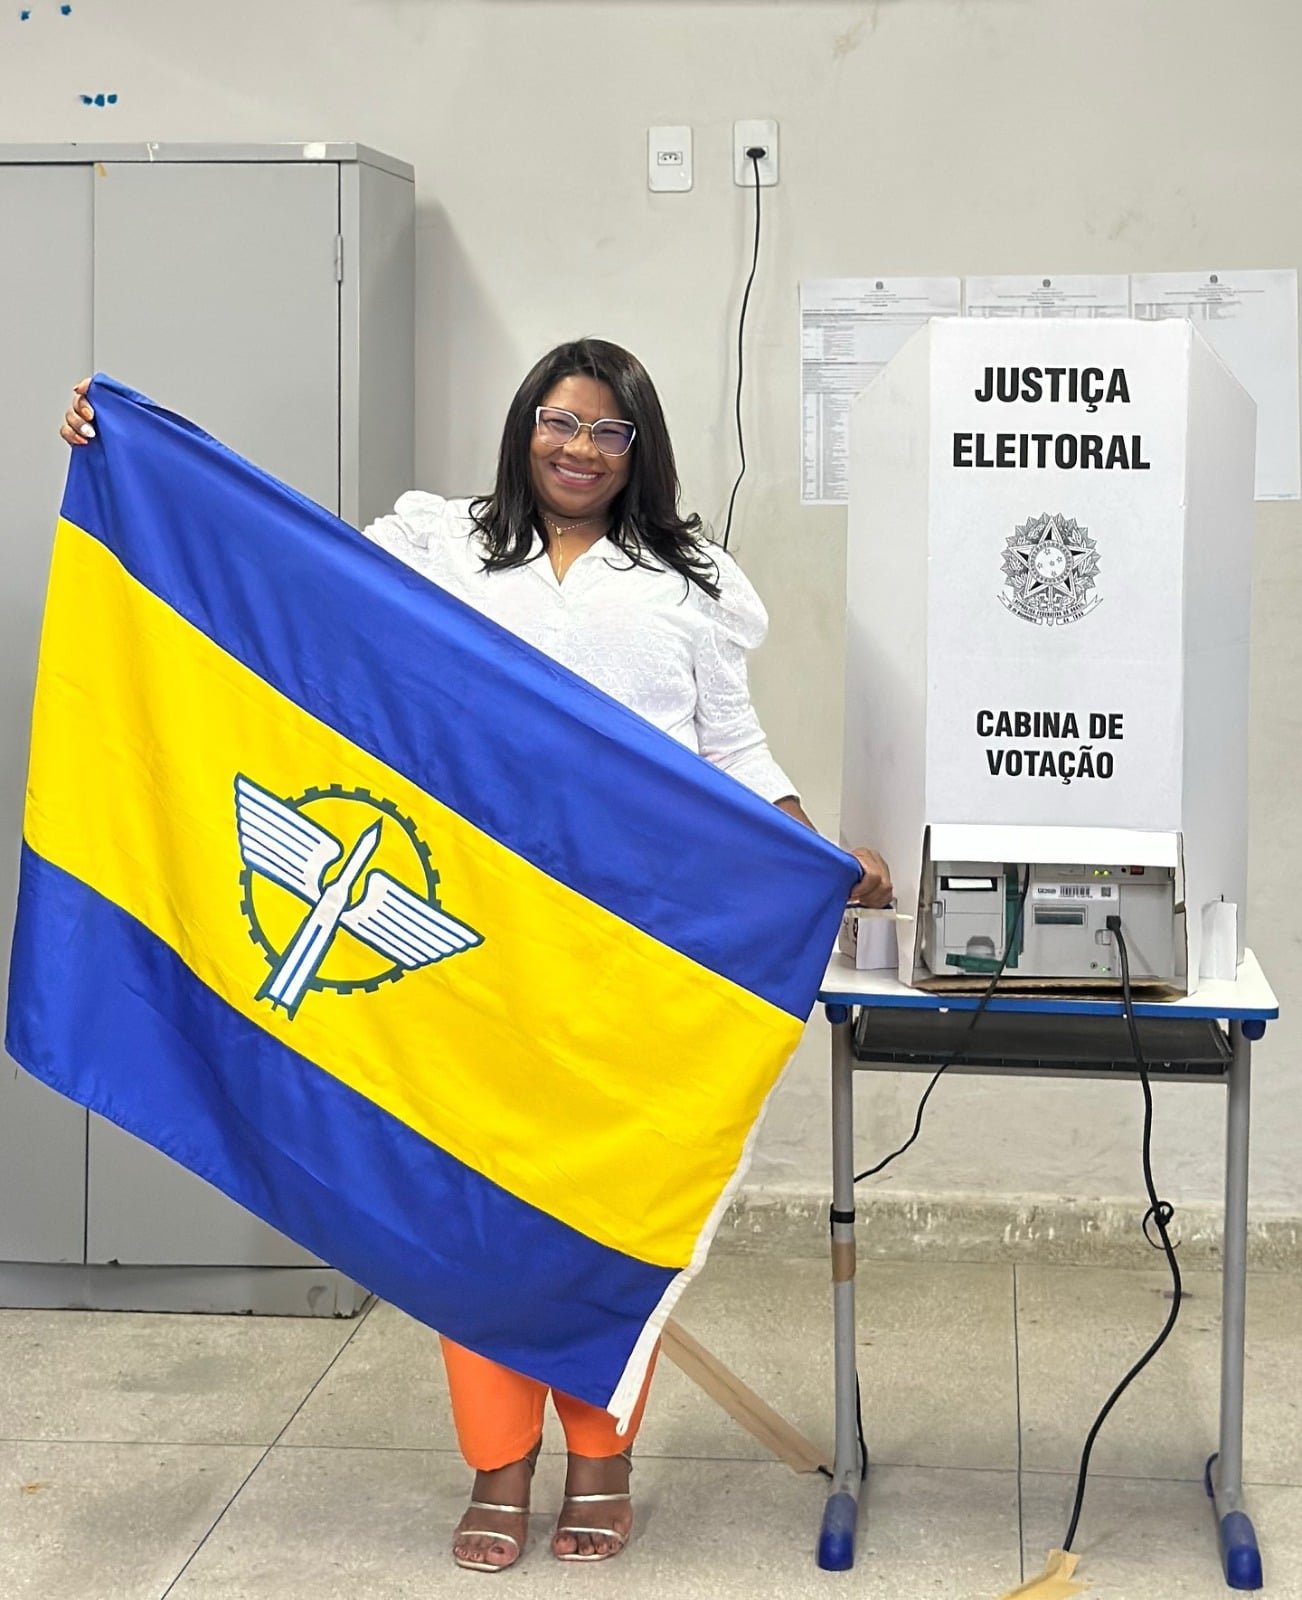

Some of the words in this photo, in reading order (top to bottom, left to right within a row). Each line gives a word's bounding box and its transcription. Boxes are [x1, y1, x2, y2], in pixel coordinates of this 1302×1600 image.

[974, 366, 1131, 413] JUSTIÇA
[953, 432, 1151, 470] ELEITORAL
[976, 710, 1080, 739] CABINA
[1089, 712, 1124, 740] DE
[986, 745, 1114, 785] VOTAÇÃO
